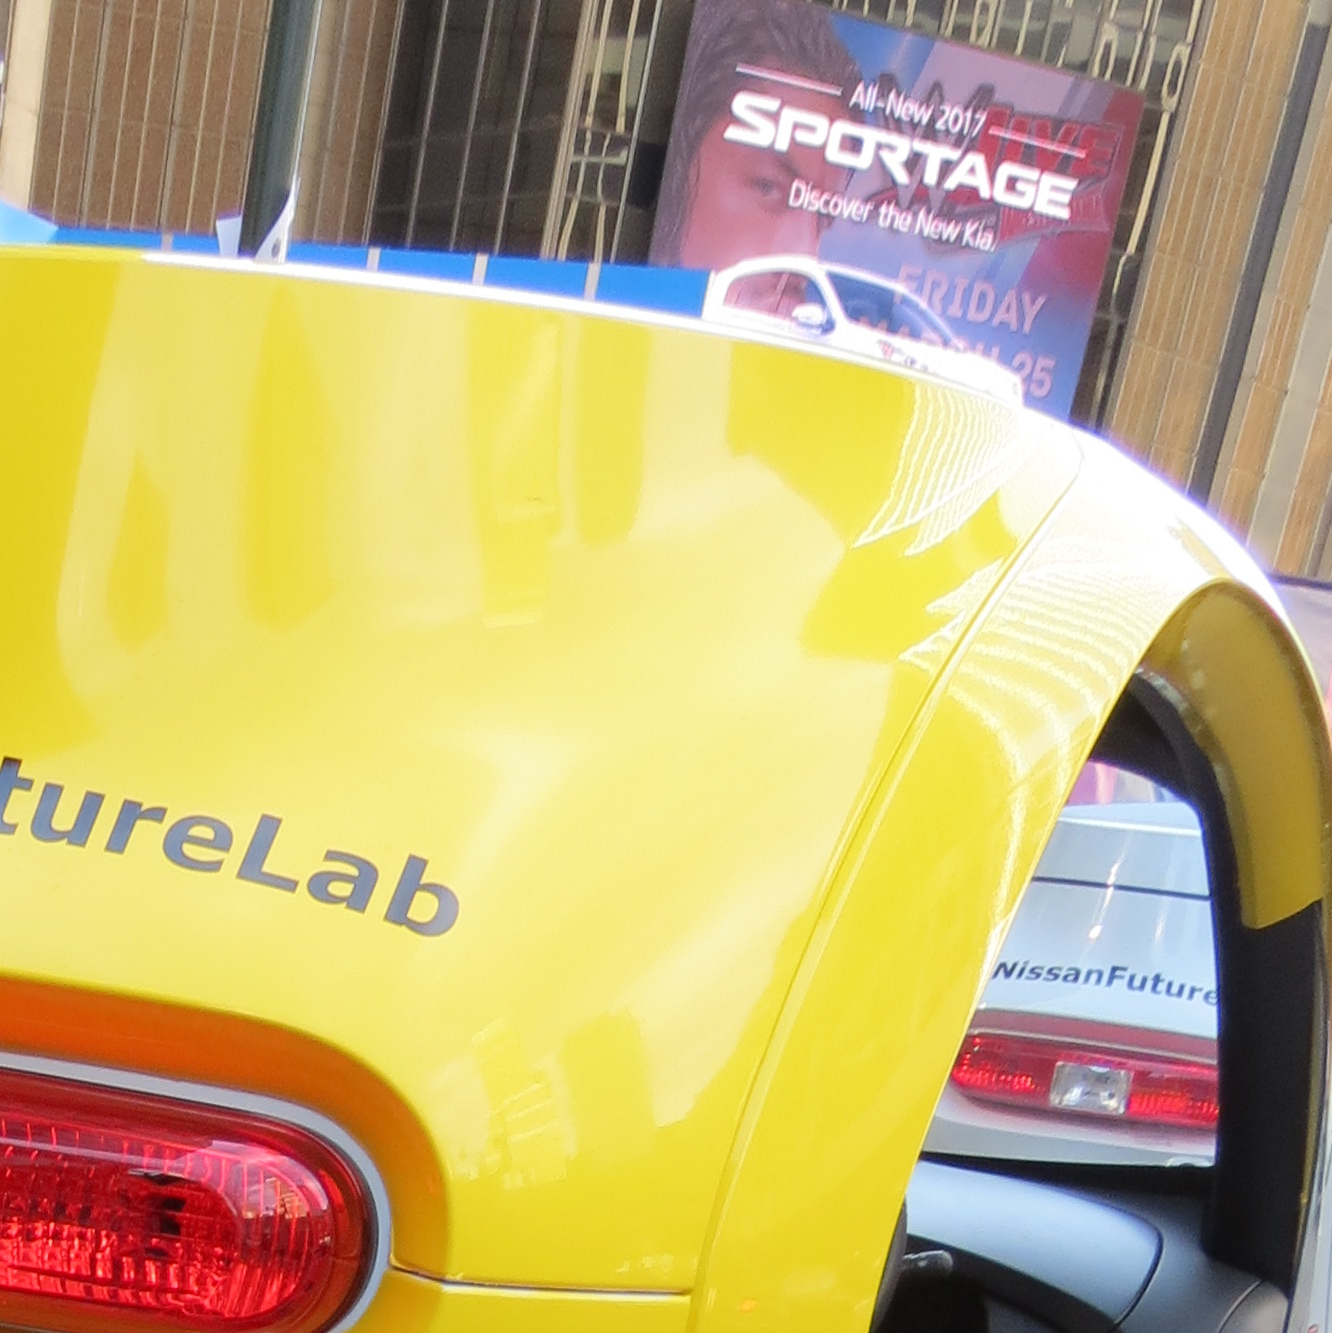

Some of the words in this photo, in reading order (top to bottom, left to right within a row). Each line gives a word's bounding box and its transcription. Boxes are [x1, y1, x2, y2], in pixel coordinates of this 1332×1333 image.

[848, 79, 932, 125] All-New
[934, 103, 988, 138] 2017
[723, 89, 1080, 221] SPORTAGE
[788, 179, 874, 223] Discover
[878, 199, 910, 232] the
[914, 208, 962, 242] New
[893, 262, 1048, 335] FRIDAY
